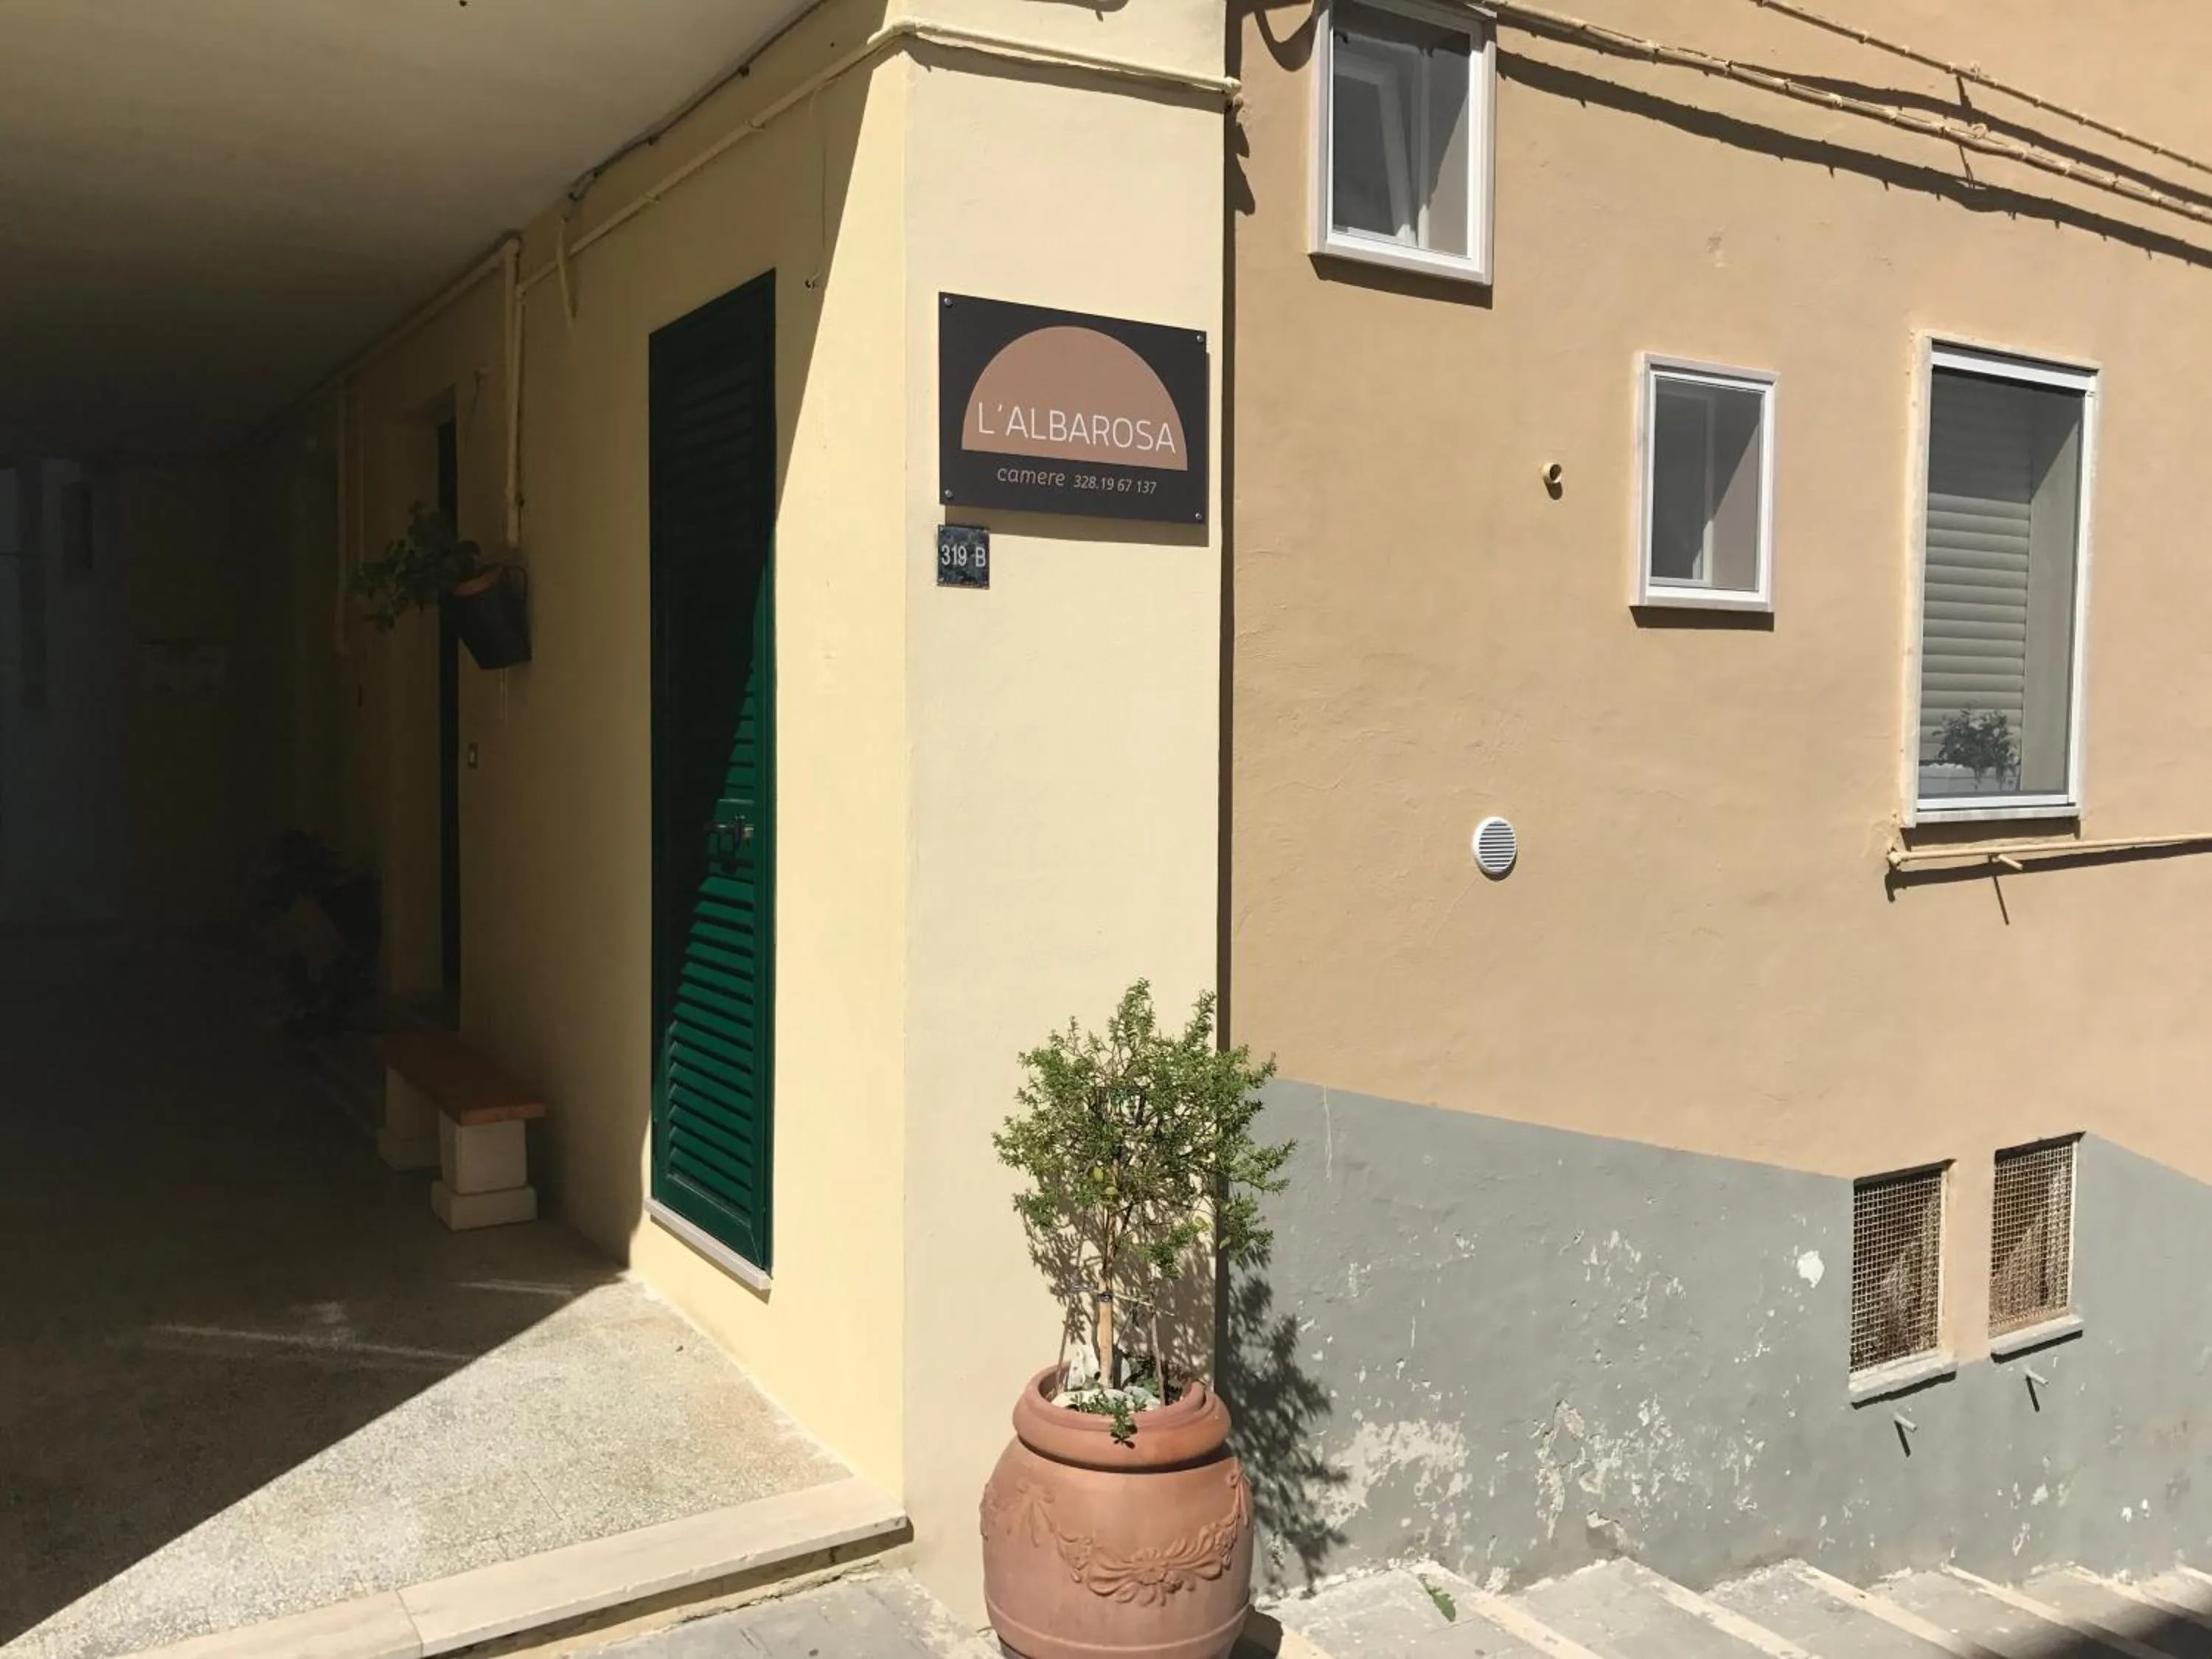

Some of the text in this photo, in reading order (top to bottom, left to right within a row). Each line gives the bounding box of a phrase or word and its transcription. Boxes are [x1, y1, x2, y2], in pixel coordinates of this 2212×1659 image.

[978, 402, 1176, 453] L'ALBAROSA
[998, 467, 1065, 487] camere
[941, 545, 986, 567] 319 B
